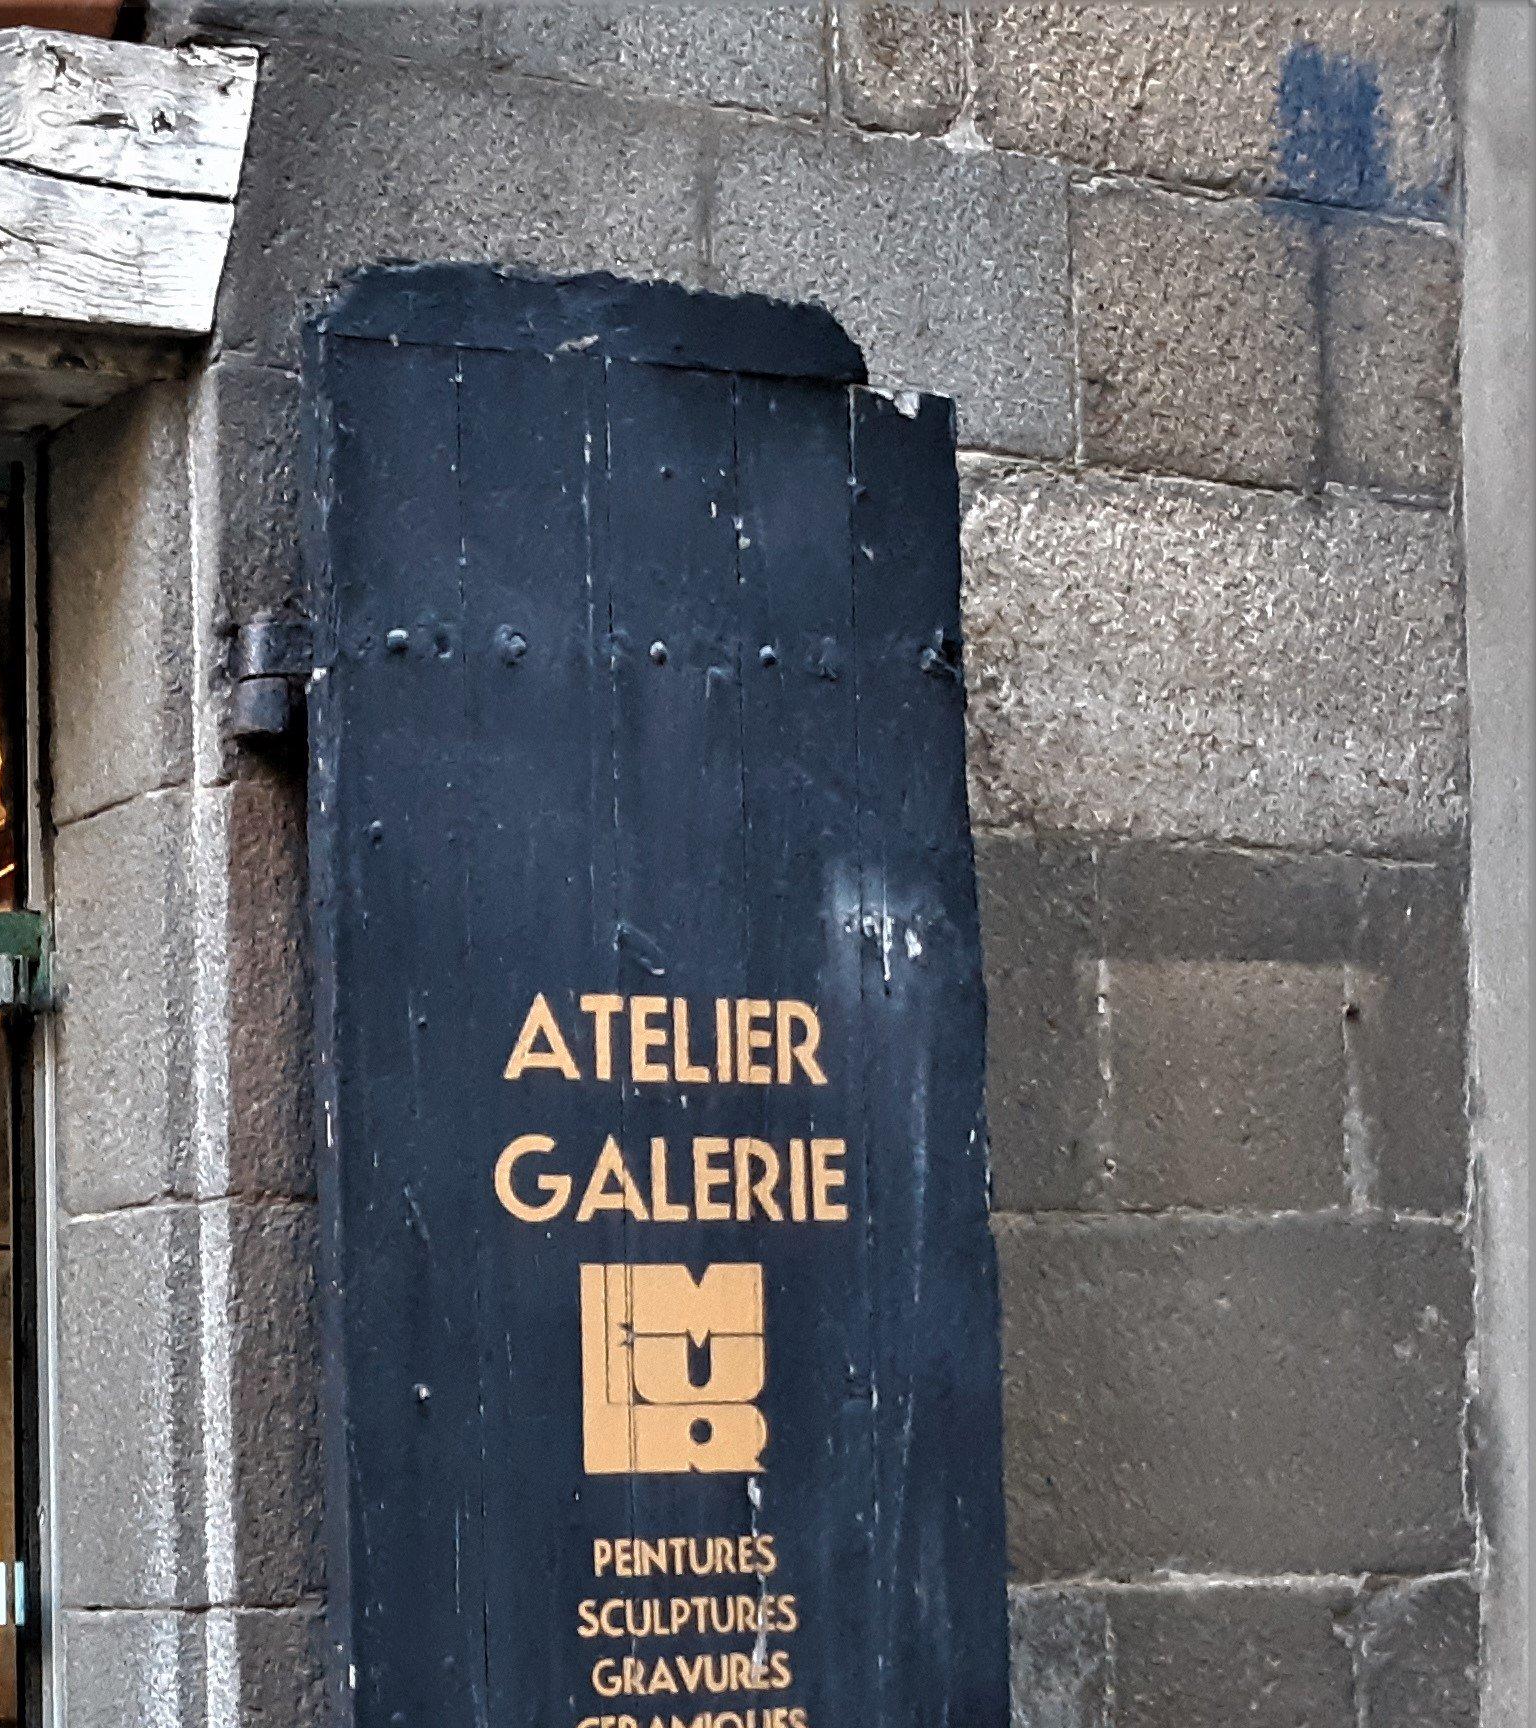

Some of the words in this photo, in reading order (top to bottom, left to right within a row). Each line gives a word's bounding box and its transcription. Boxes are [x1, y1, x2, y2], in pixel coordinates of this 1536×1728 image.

[503, 992, 828, 1085] ATELIER
[494, 1133, 848, 1222] GALERIE
[593, 1535, 778, 1578] PEINTURES
[577, 1594, 799, 1638] SCULPTURES
[591, 1651, 793, 1697] GRAVURES
